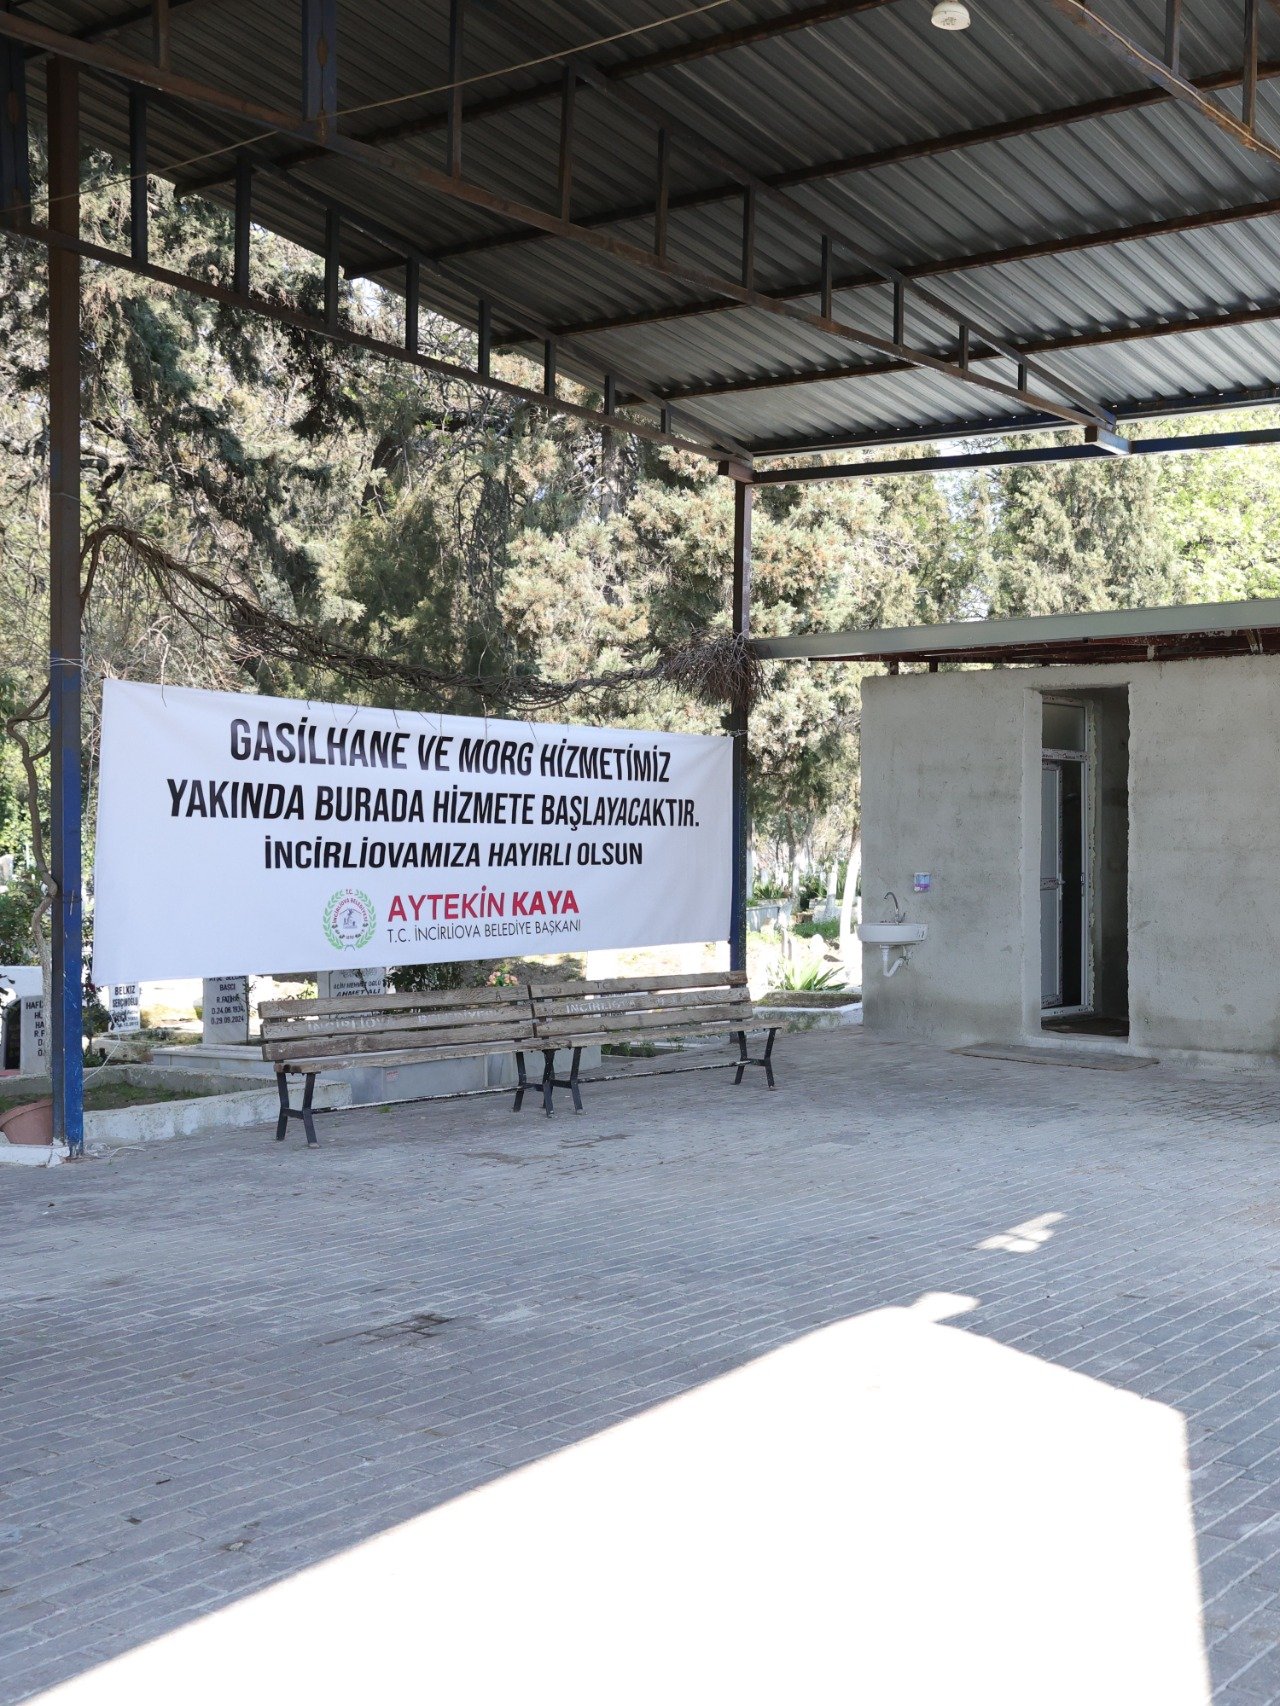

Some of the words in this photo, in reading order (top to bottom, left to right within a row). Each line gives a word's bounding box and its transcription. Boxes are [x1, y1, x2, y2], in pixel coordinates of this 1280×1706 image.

[230, 716, 411, 770] GASİLHANE
[418, 734, 454, 772] VE
[458, 738, 534, 777] MORG
[540, 739, 671, 783] HİZMETİMİZ
[166, 778, 305, 820] YAKINDA
[315, 785, 425, 823] BURADA
[433, 785, 536, 826] HİZMETE
[541, 795, 700, 831] BAŞLAYACAKTIR.
[264, 835, 481, 869] İNCİRLİOVAMIZA
[488, 842, 571, 868] HAYIRLI
[577, 842, 643, 865] OLSUN
[387, 885, 505, 922] AYTEKİN
[511, 889, 580, 917] KAYA
[387, 928, 411, 943] T.C.
[414, 922, 481, 942] İNCİRLİOVA
[484, 919, 532, 938] BELEDİYE
[535, 918, 581, 936] BAŞKANI
